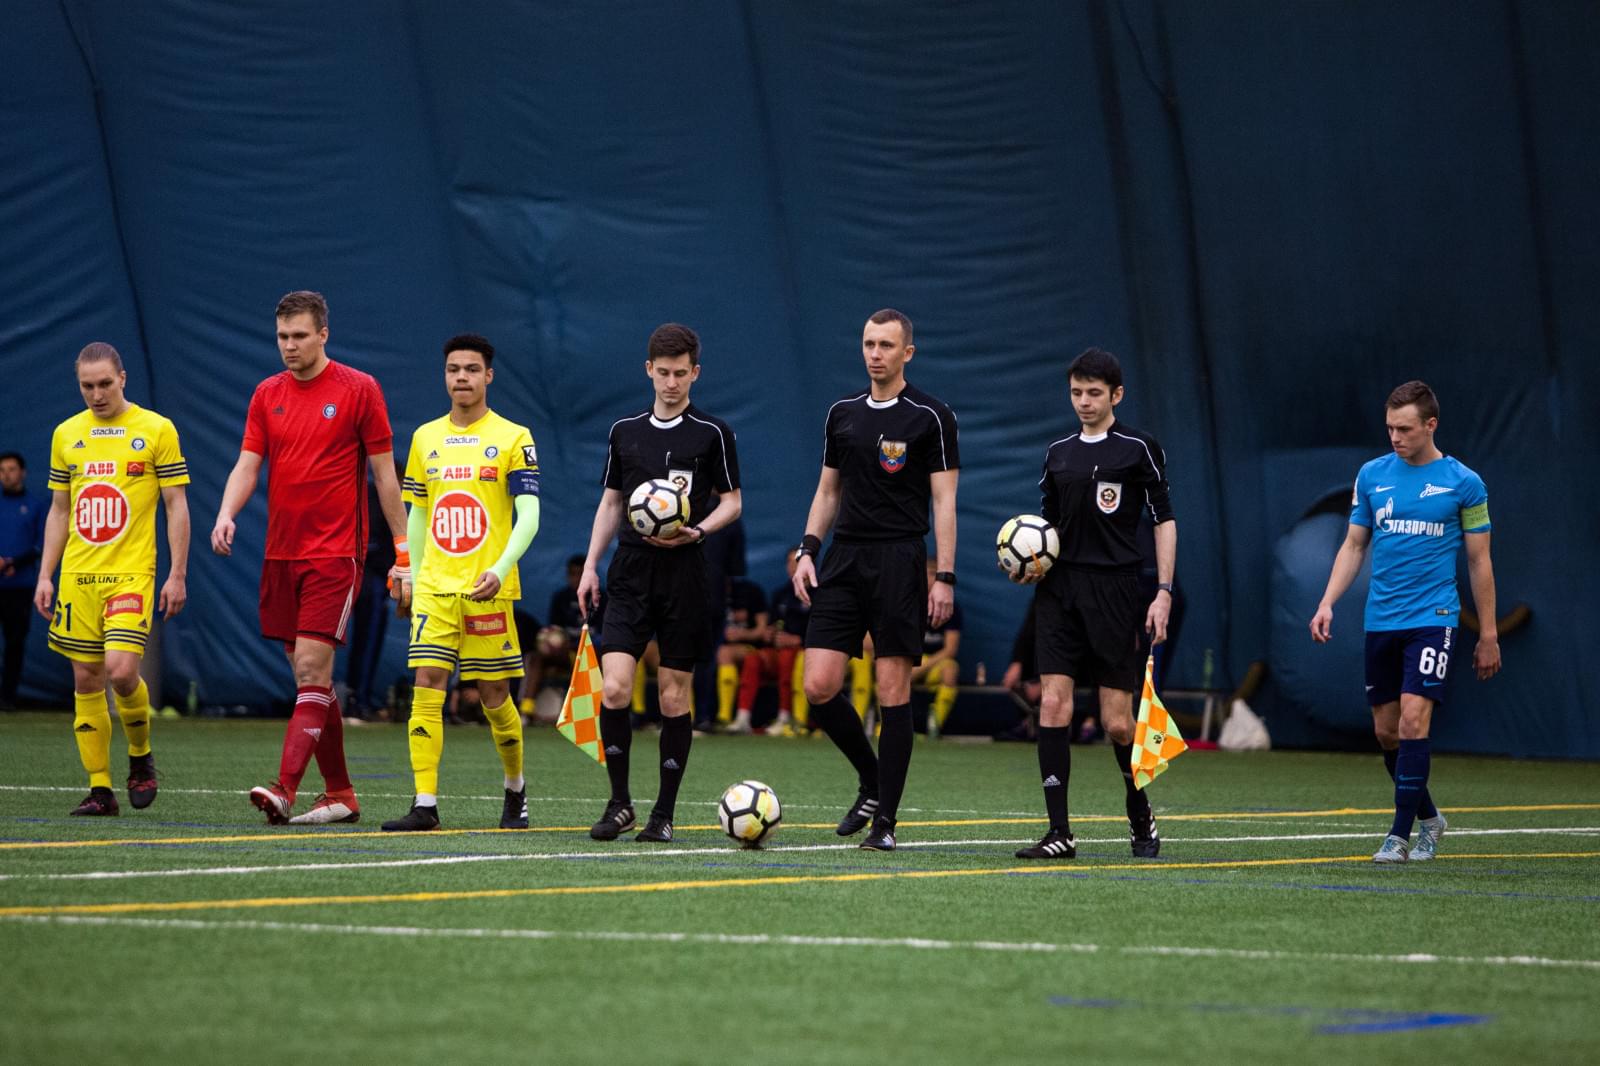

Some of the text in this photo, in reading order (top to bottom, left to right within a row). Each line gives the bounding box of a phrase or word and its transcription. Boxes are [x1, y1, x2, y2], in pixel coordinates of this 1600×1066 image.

[91, 428, 125, 436] stadium
[446, 437, 479, 445] stadium
[86, 463, 115, 475] ABB
[443, 467, 472, 480] ABB
[79, 497, 122, 539] apu
[435, 507, 481, 550] apu
[1393, 520, 1445, 537] ГАЗПРОМ
[98, 576, 120, 584] LINE
[1419, 646, 1449, 680] 68
